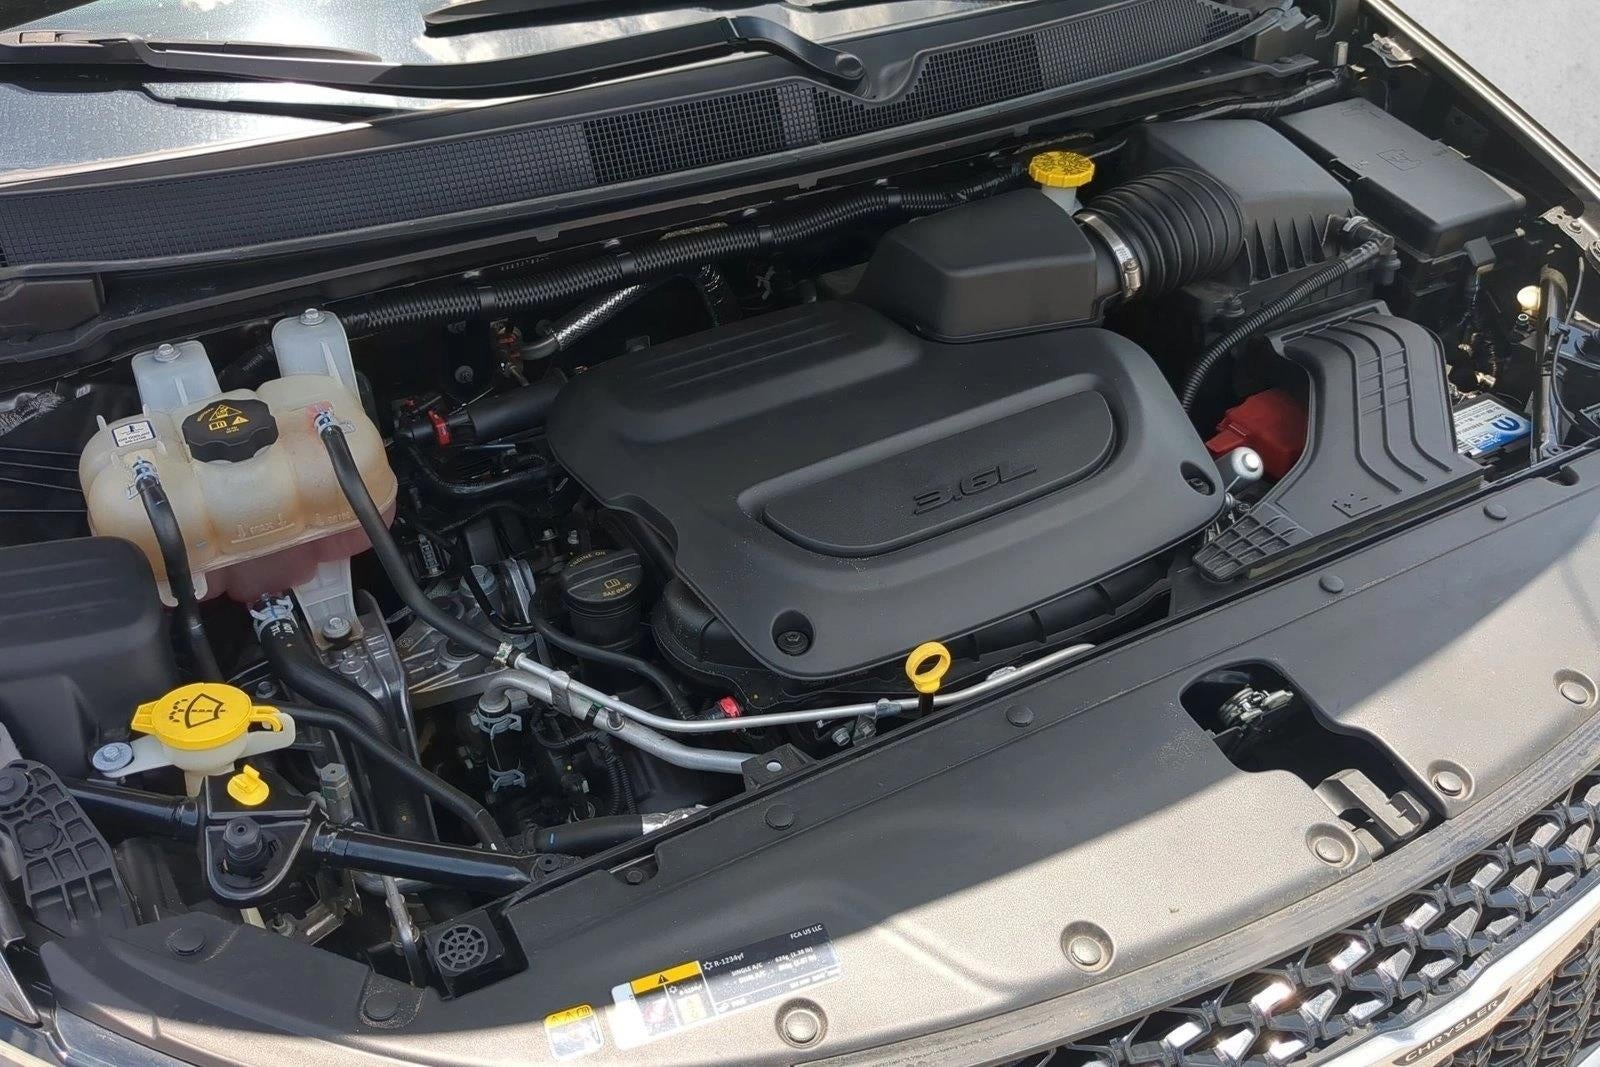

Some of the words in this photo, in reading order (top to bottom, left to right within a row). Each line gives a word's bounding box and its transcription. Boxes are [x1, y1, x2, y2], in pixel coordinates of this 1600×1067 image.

[912, 464, 1038, 515] 3.6L
[790, 931, 802, 940] FCA
[802, 928, 811, 936] US
[811, 924, 823, 933] LLC
[713, 952, 745, 967] R-1234yf
[1405, 1000, 1498, 1062] CHRYSLER
